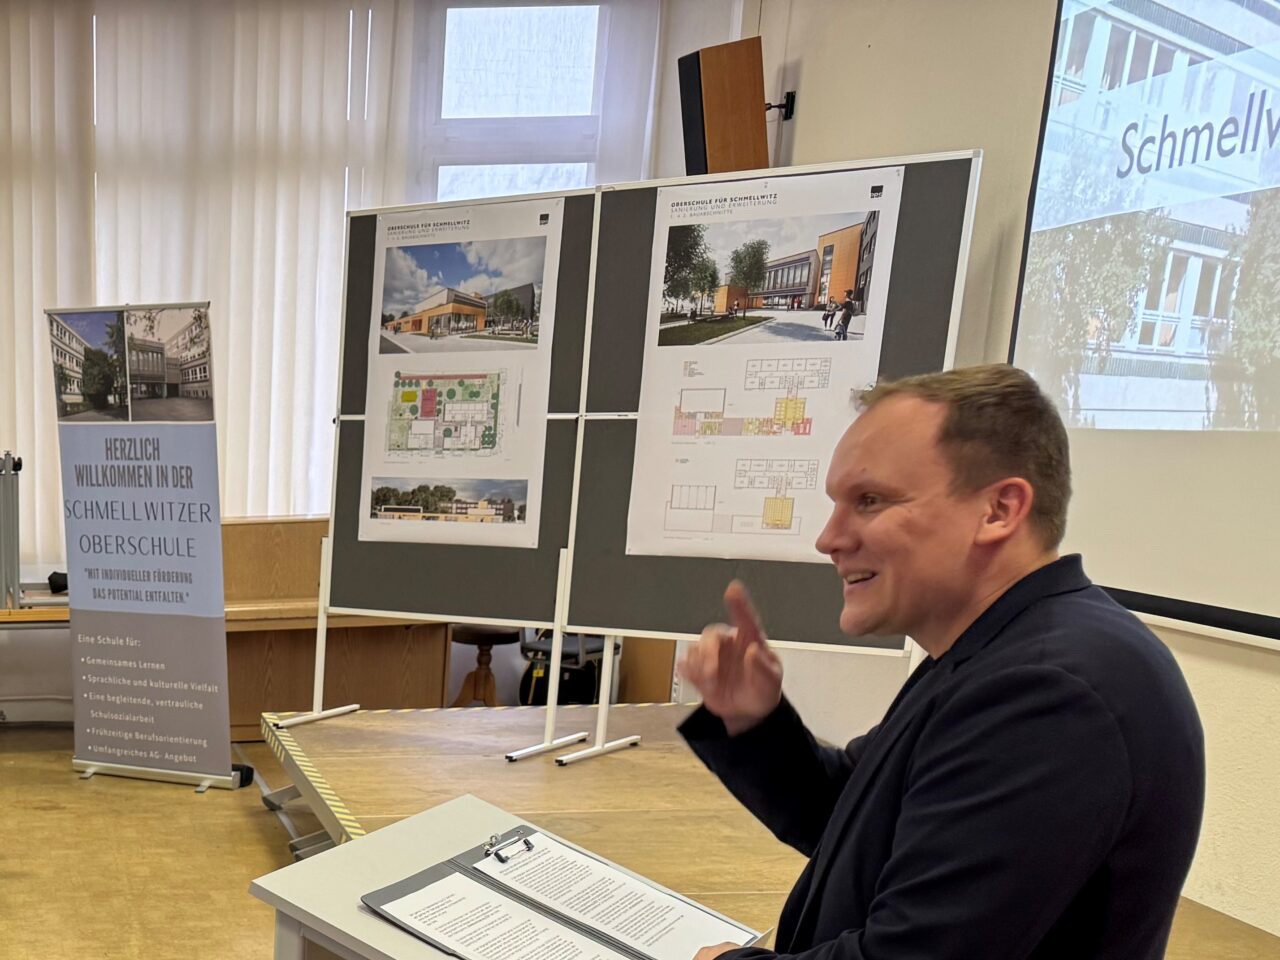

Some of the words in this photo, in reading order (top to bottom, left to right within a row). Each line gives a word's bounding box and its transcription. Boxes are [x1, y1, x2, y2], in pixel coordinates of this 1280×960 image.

[671, 199, 712, 208] OBERSCHULE
[729, 194, 778, 203] SCHMELLWITZ
[671, 205, 708, 213] SANIERUNG
[728, 200, 777, 208] ERWEITERUNG
[433, 220, 471, 228] SCHMELLWITZ
[105, 437, 160, 461] HERZLICH
[74, 464, 153, 488] WILLKOMMEN
[156, 465, 169, 488] IN
[172, 466, 194, 489] DER
[65, 499, 212, 523] SCHMELLWITZER
[79, 534, 197, 558] OBERSCHULE
[101, 568, 151, 582] INDIVIDUELLER
[153, 568, 193, 584] FÖRDERUNG
[92, 588, 106, 600] DAS
[107, 588, 144, 602] POTENTIAL
[77, 634, 95, 644] Eine
[97, 635, 124, 647] Schule
[126, 637, 141, 647] für:
[86, 656, 137, 668] Gemeinsames
[138, 660, 166, 670] Lernen
[87, 674, 131, 686] Sprachliche
[133, 678, 148, 687] und
[149, 679, 189, 690] kulturelle
[190, 682, 219, 693] Vielfalt
[89, 692, 105, 701] Eine
[106, 694, 154, 706] begleitende,
[155, 698, 204, 710] vertrauliche
[90, 710, 155, 724] Schulsozialarbeit
[91, 727, 133, 740] Frühzeitige
[134, 731, 208, 748] Berufsorientierung
[93, 745, 148, 759] Umfangreiches
[164, 752, 197, 763] Angebot
